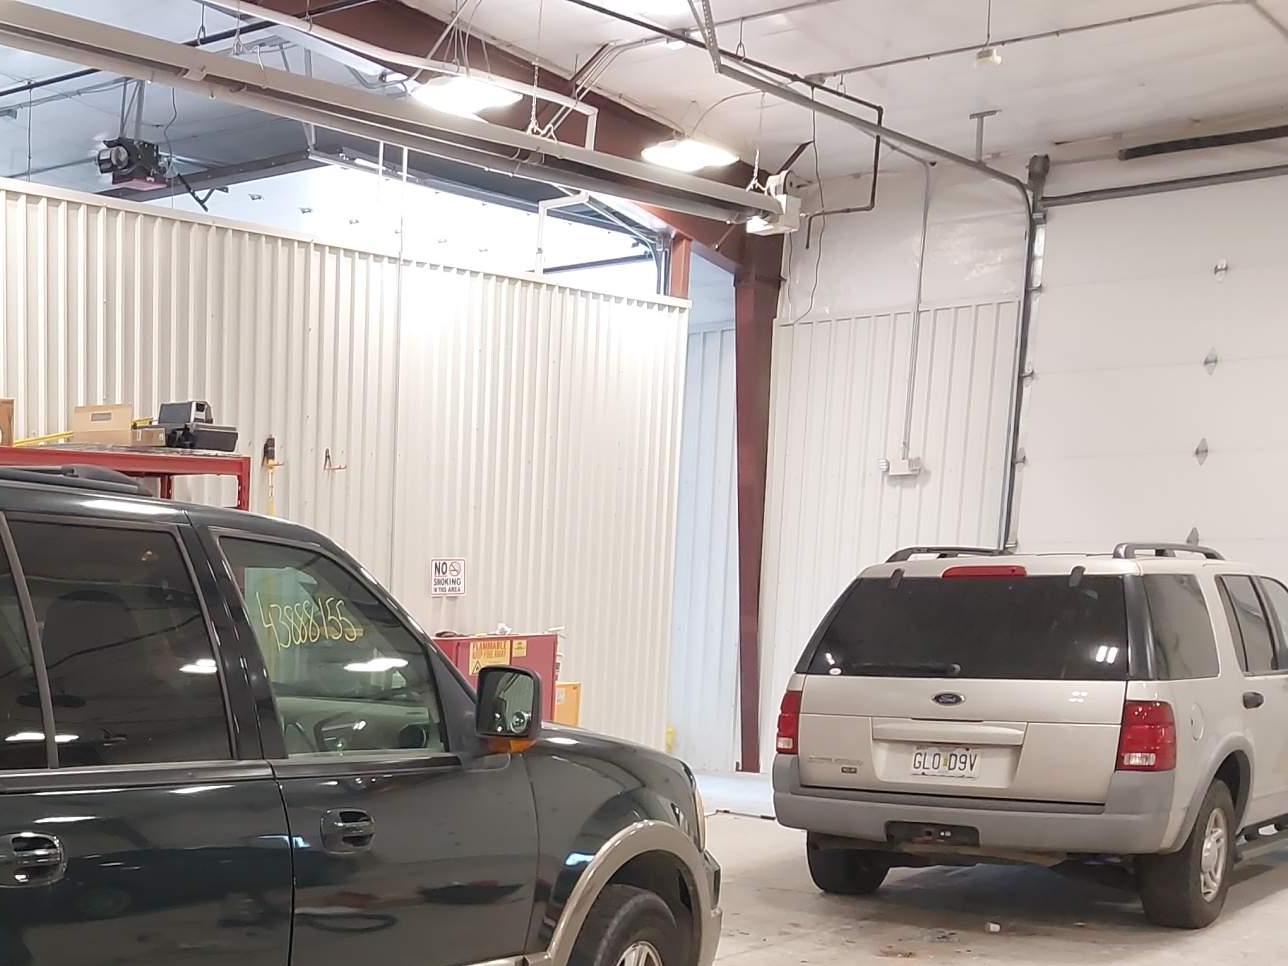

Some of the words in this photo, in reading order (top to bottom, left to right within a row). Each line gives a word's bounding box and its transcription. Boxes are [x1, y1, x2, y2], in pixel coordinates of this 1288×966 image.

[434, 561, 448, 576] NO
[433, 577, 462, 586] SMOKING
[255, 591, 358, 652] 43888155
[947, 753, 978, 771] D9V
